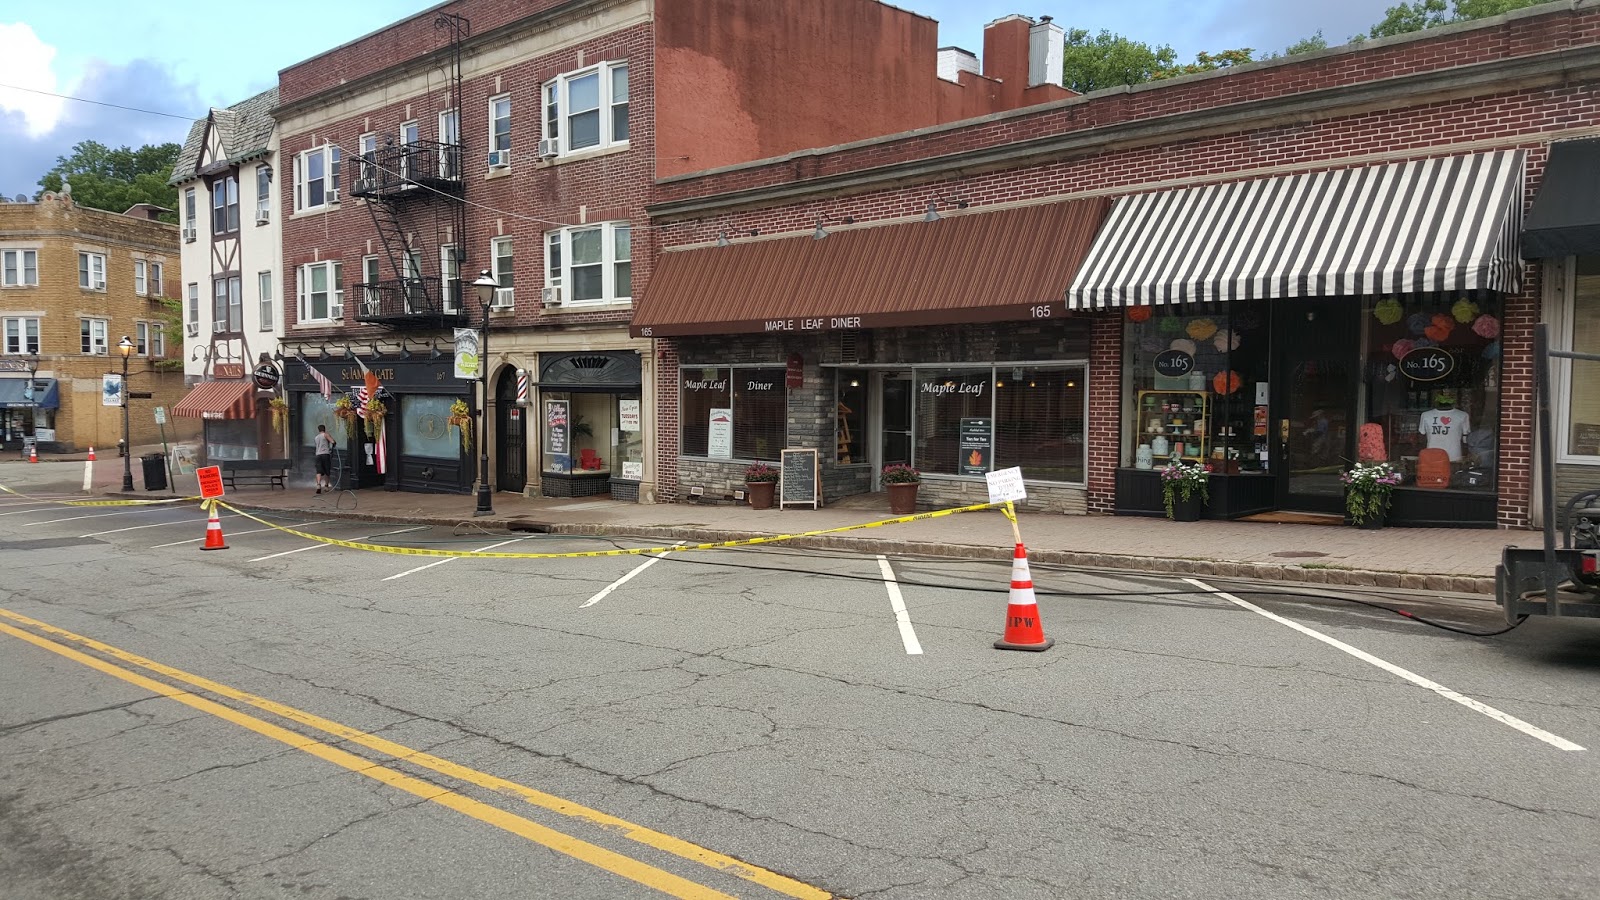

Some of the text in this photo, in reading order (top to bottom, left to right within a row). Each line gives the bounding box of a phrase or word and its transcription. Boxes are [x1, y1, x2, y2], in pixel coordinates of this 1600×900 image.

[1030, 305, 1051, 318] 165
[765, 317, 861, 331] MAPLE LEAF DINER
[641, 327, 653, 337] 165
[1171, 355, 1188, 370] 165
[1407, 353, 1446, 372] No. 165
[223, 365, 242, 377] NAILS
[374, 368, 394, 380] GATE
[684, 379, 727, 393] Maple Leaf
[747, 380, 773, 391] Diner
[921, 380, 986, 397] Maple Leaf
[1432, 417, 1438, 425] I
[1432, 426, 1450, 435] NJ
